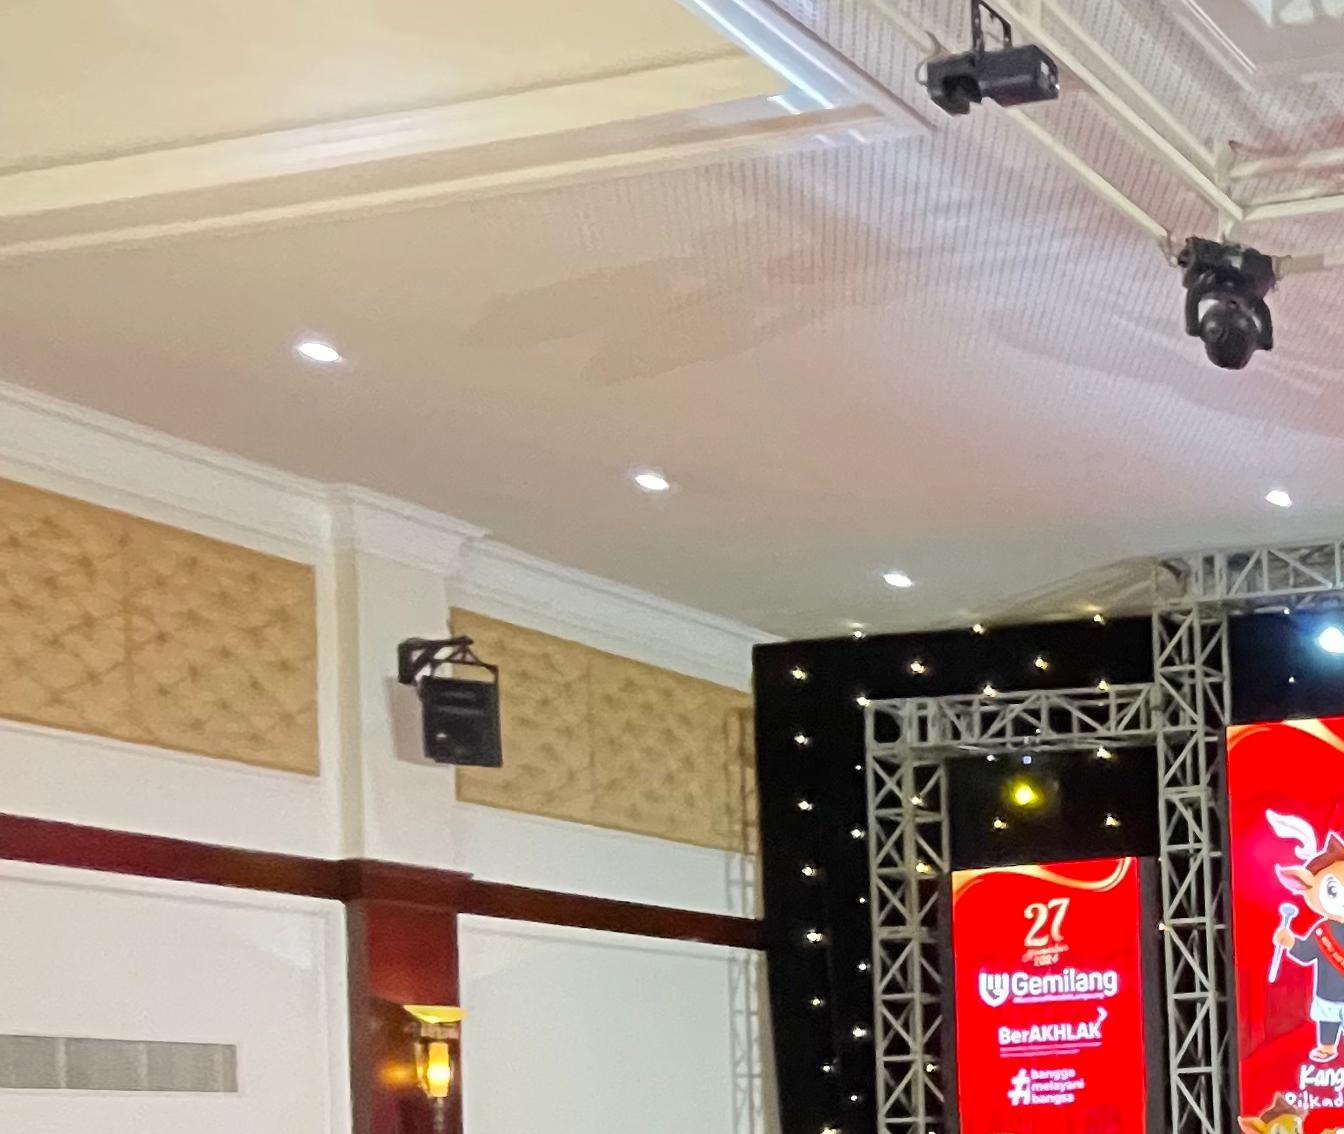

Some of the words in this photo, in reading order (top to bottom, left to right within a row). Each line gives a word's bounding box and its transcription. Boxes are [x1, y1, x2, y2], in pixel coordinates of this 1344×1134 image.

[1023, 897, 1071, 947] 27
[1011, 967, 1119, 997] Gemilang
[998, 1021, 1102, 1046] BerAKHLAK
[1030, 1068, 1077, 1081] bangga
[1031, 1077, 1086, 1092] melayani
[1031, 1093, 1076, 1105] bangsa
